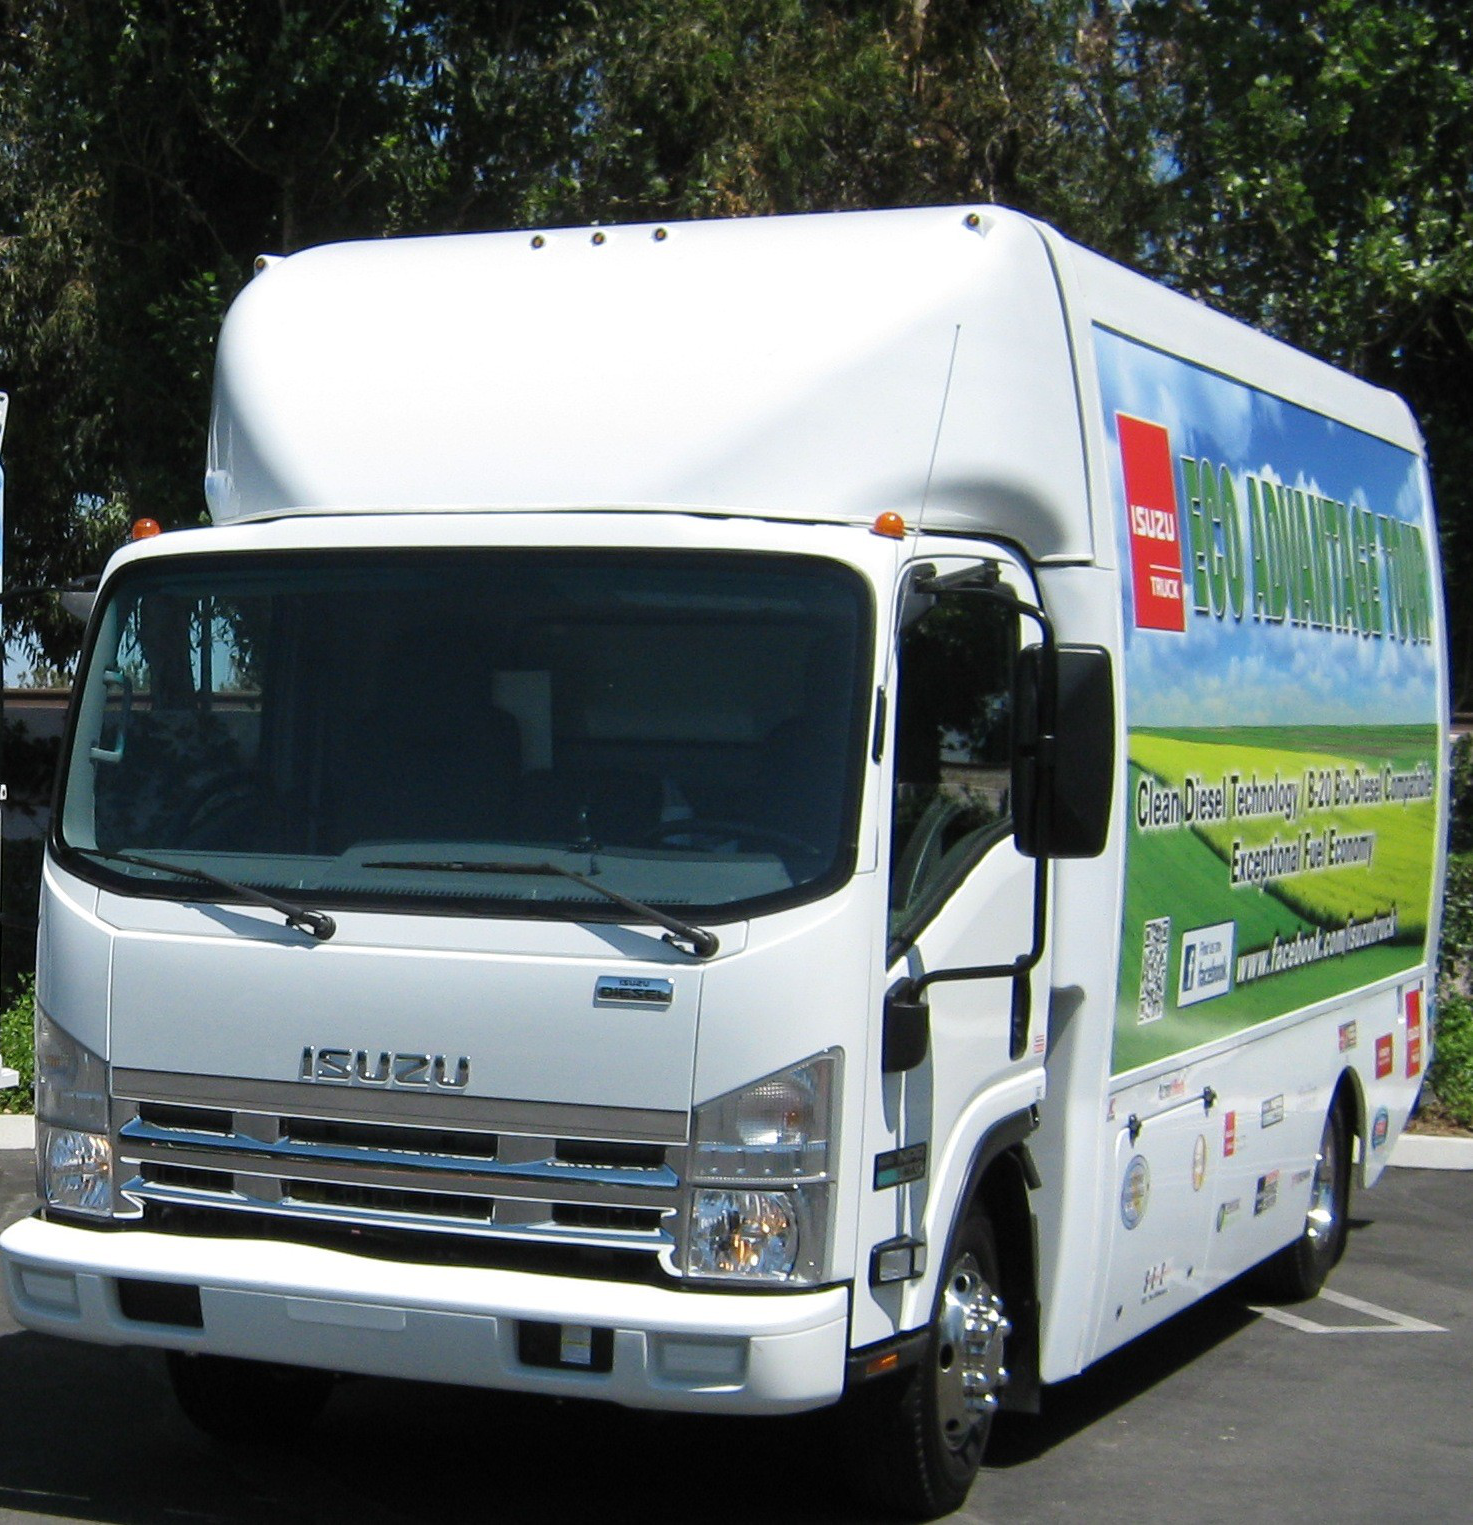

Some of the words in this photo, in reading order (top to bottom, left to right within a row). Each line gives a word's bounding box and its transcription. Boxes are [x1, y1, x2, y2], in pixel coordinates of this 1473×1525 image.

[1130, 503, 1176, 543] ISUZU
[1180, 455, 1245, 620] ECO
[1149, 575, 1179, 599] TRUCK
[1137, 777, 1181, 828] Clean
[1184, 776, 1227, 822] Diesel
[1230, 772, 1298, 821] Technology
[300, 1046, 472, 1090] ISUZU
